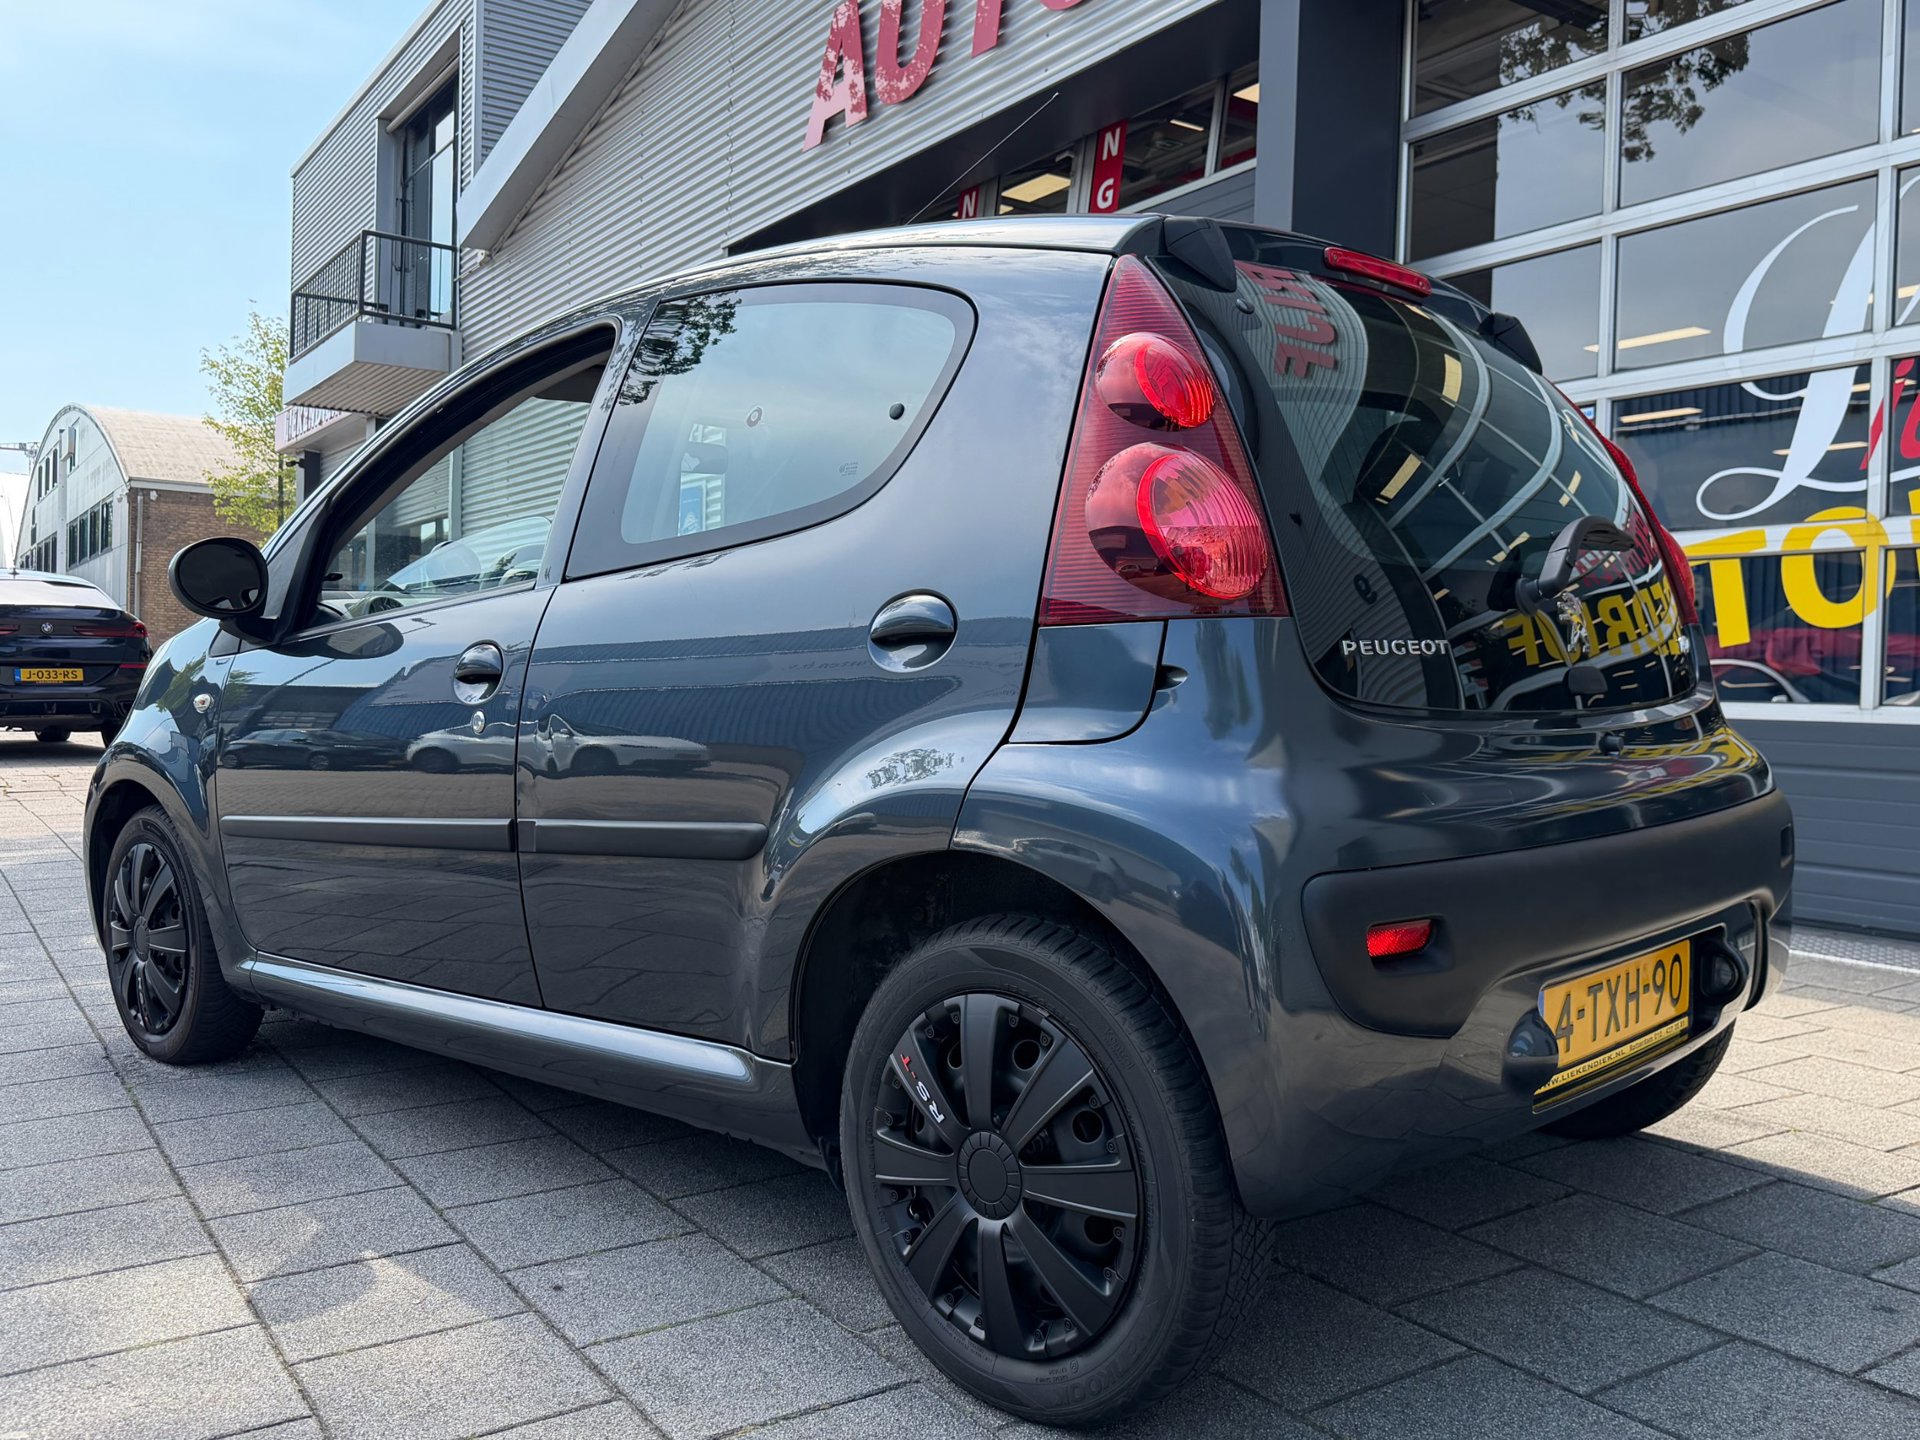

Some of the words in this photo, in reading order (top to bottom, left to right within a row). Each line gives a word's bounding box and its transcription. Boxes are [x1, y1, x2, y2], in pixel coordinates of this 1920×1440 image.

[801, 0, 1084, 152] AU
[1342, 639, 1449, 656] PEUGEOT
[26, 670, 78, 679] J-033-RS
[1555, 952, 1683, 1053] 4-TXH-90
[1538, 1049, 1626, 1092] W.LIEKENDIEK.NL
